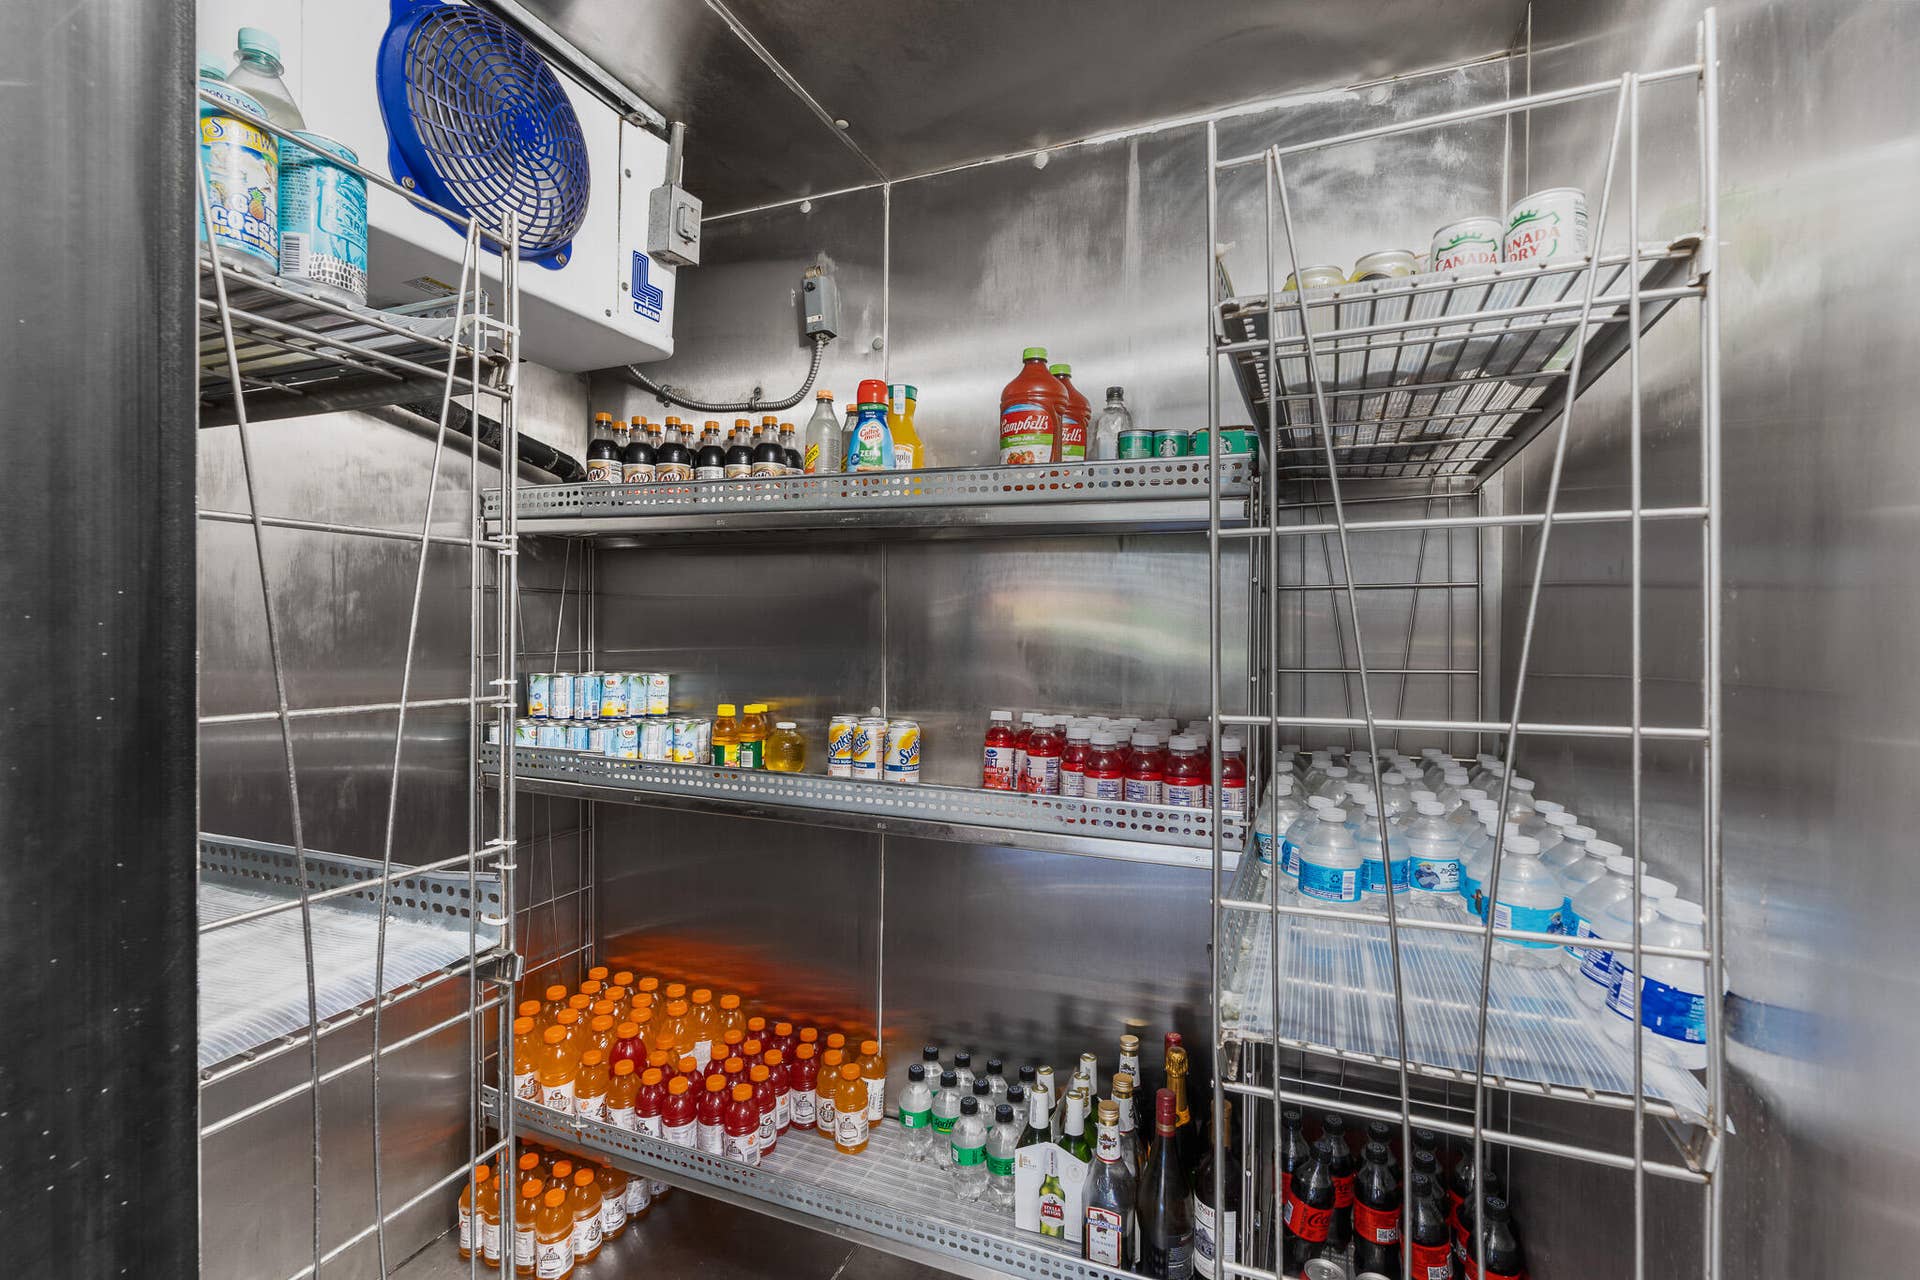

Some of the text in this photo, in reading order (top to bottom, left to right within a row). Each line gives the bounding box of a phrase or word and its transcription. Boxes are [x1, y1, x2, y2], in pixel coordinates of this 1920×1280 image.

[1508, 227, 1560, 253] NADA
[634, 302, 660, 322] LARKIN
[1001, 415, 1049, 434] Campbell's
[934, 1118, 955, 1128] Sprit
